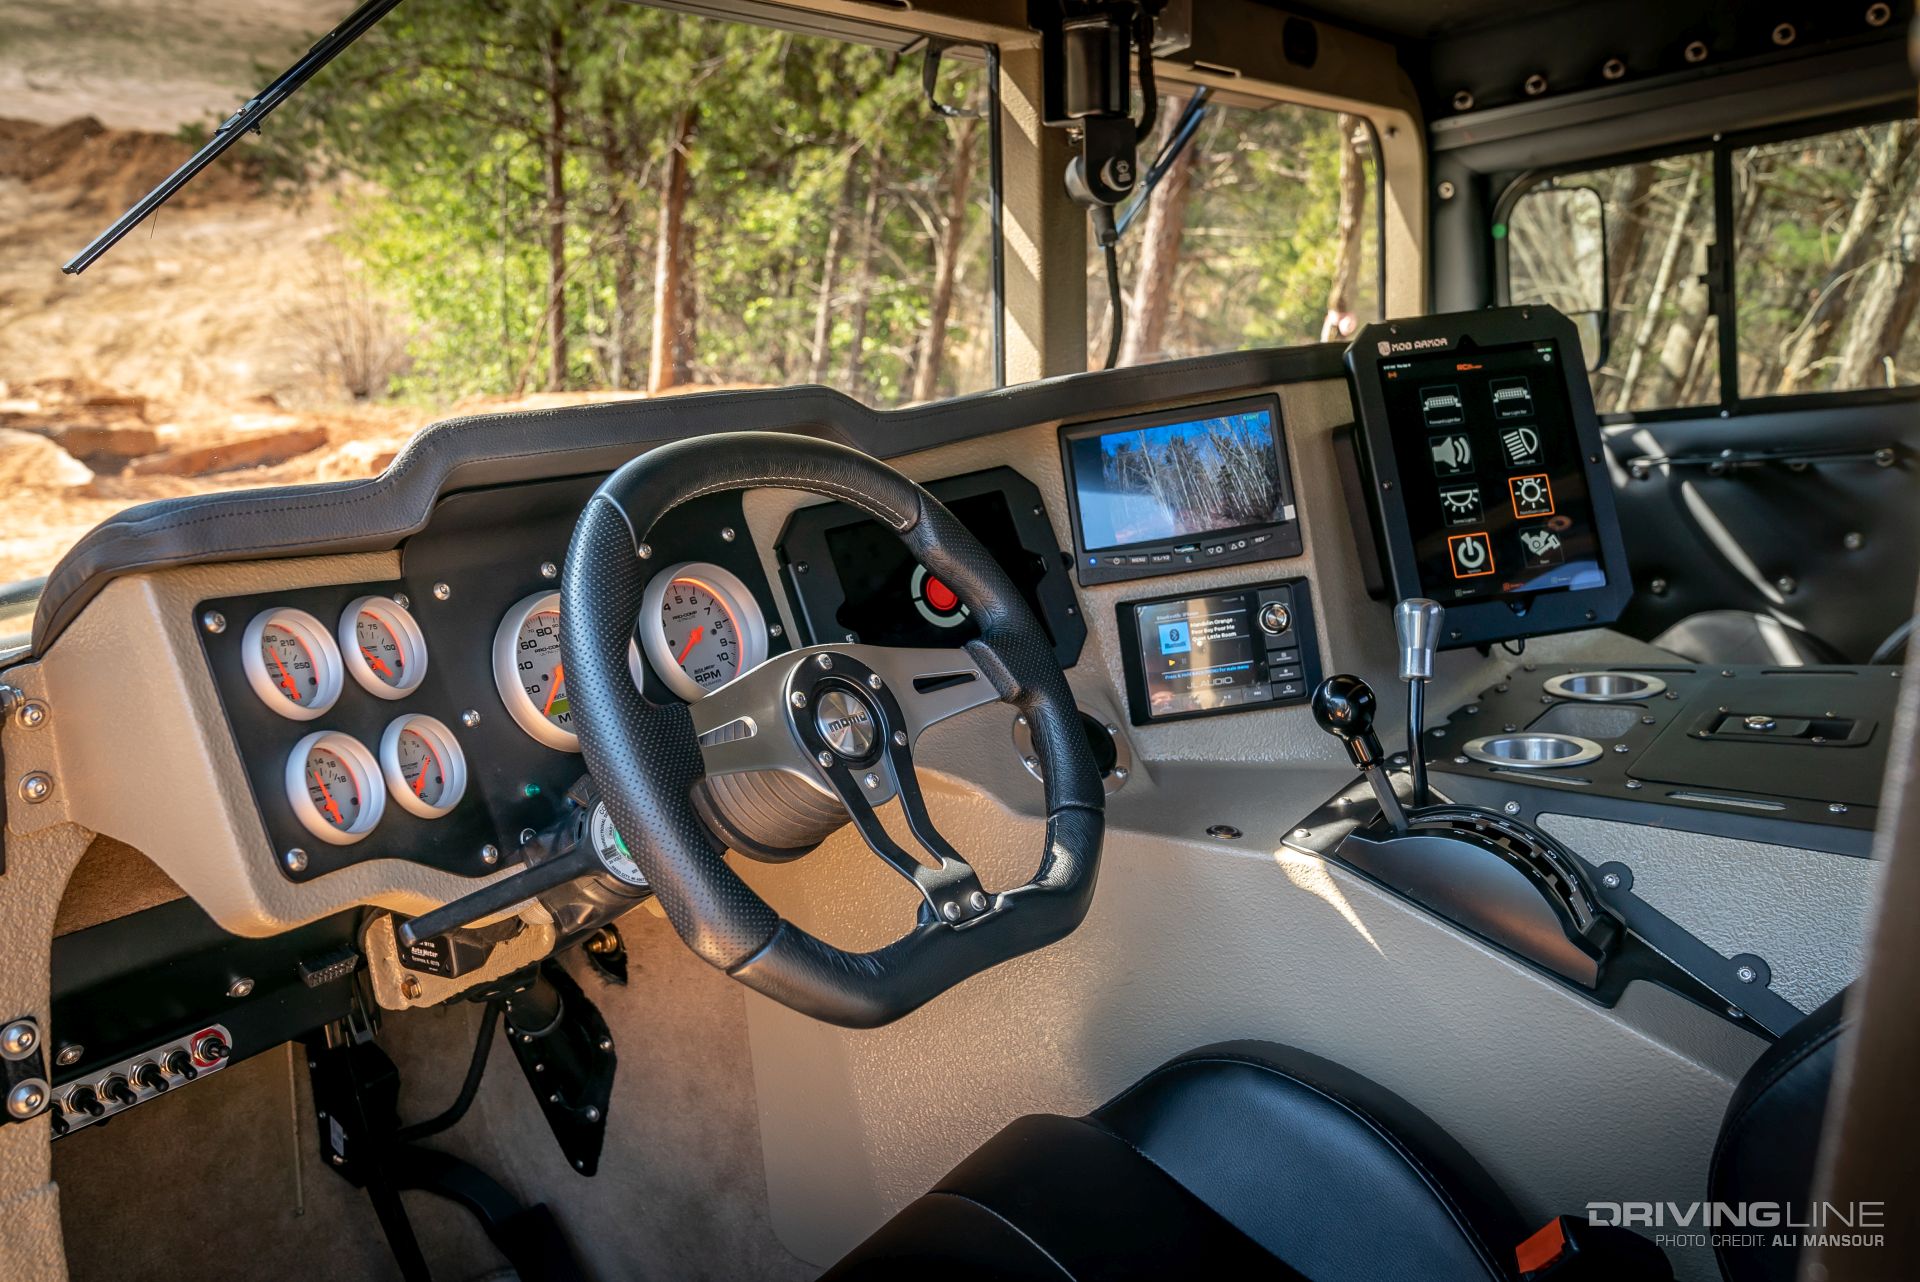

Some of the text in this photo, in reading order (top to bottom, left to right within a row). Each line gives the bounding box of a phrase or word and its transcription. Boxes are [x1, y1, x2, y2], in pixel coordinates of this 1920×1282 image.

[1391, 337, 1448, 352] MOB ARMOR
[1254, 535, 1265, 543] REV
[1131, 556, 1146, 564] MENU
[674, 595, 684, 605] 5
[689, 596, 698, 605] 6
[663, 602, 672, 612] 4
[704, 607, 712, 616] 7
[714, 620, 723, 630] 8
[536, 626, 553, 638] 80
[279, 639, 296, 647] 210
[520, 639, 538, 650] 60
[719, 637, 728, 647] 9
[716, 651, 730, 662] 10
[293, 661, 311, 670] 250
[518, 660, 534, 671] 40
[695, 669, 722, 684] RPM
[525, 684, 541, 695] 20
[336, 775, 347, 784] 18
